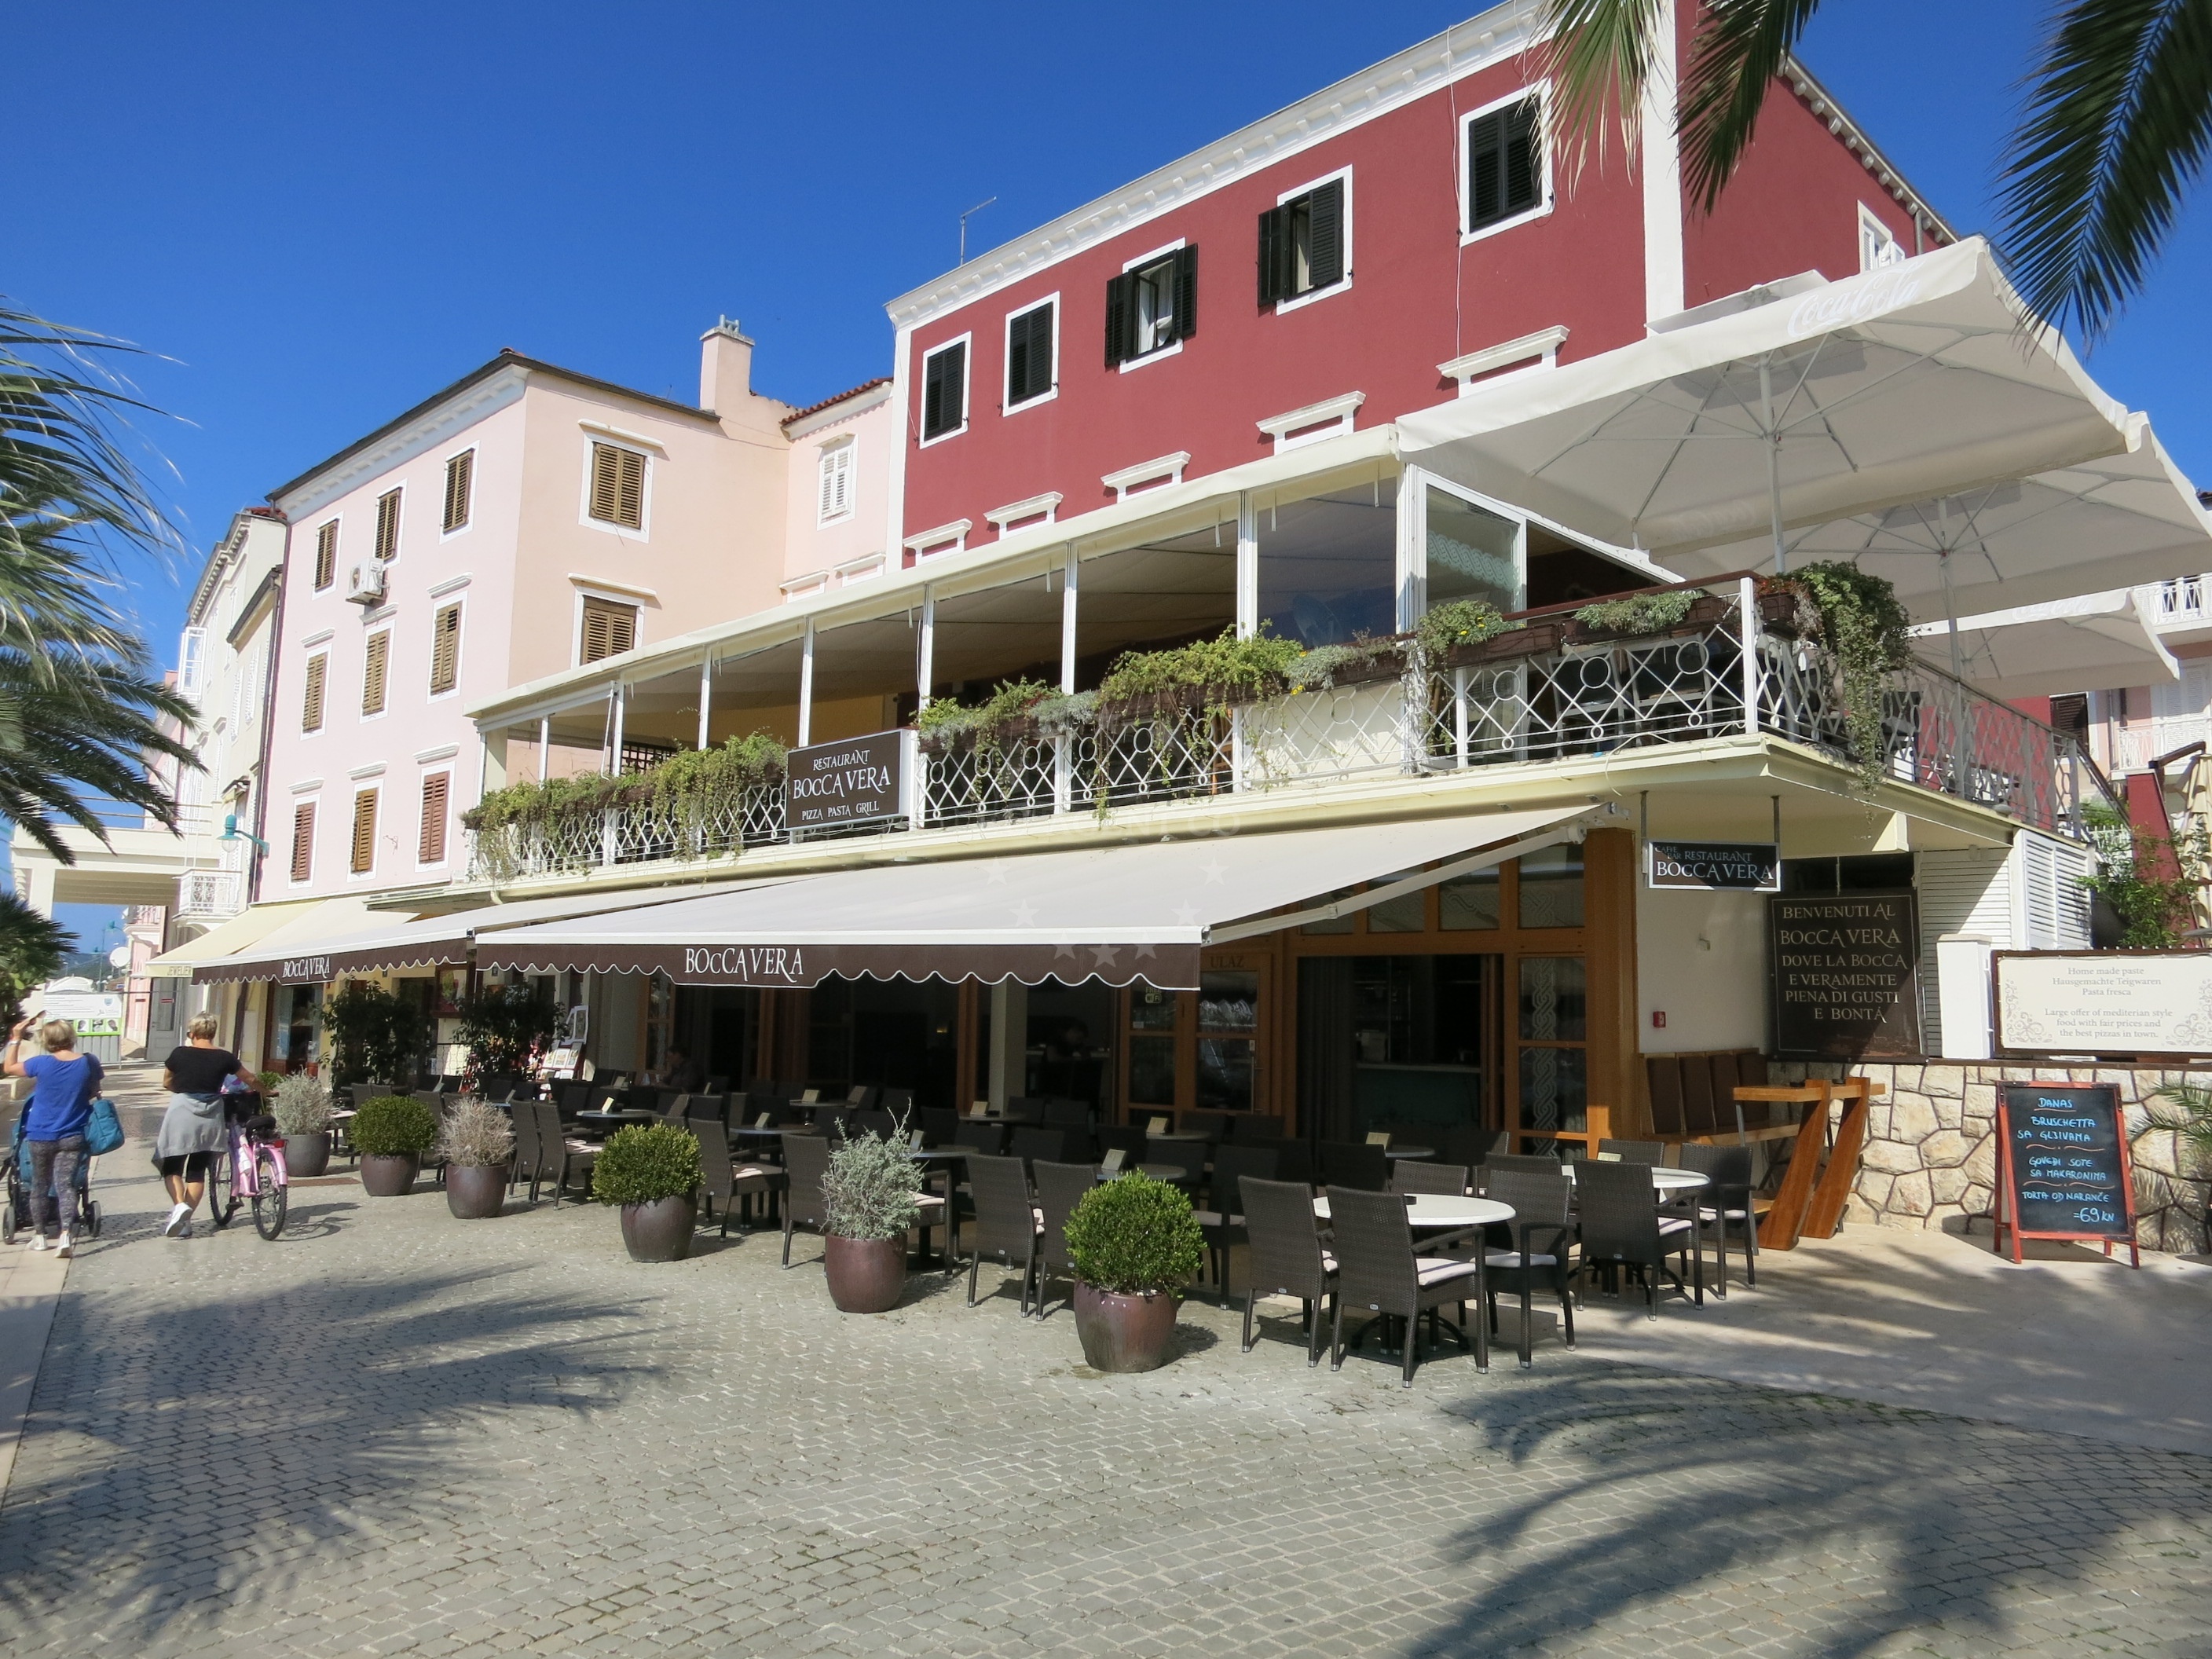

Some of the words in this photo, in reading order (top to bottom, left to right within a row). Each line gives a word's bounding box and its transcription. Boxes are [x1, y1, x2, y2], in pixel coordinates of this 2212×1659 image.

[813, 749, 870, 771] RESTAURANT
[793, 773, 845, 800] BOCCA
[845, 765, 891, 793] VERA
[801, 808, 823, 821] PIZZA
[828, 804, 851, 818] PASTA
[856, 801, 880, 816] GRILL
[1684, 851, 1752, 863] RESTAURANT
[1656, 861, 1722, 881] BOCCA
[1722, 864, 1774, 884] VERA
[1783, 905, 1870, 919] BENVENUTI
[1873, 903, 1895, 921] AL
[1780, 930, 1846, 948] BOCCA
[1846, 928, 1902, 948] VERA
[684, 947, 748, 982] BOCCA
[749, 947, 804, 983] VERA
[1210, 955, 1245, 968] ULAZ
[1782, 955, 1822, 968] DOVE
[1826, 954, 1846, 967] LA
[1851, 954, 1909, 971] BOCCA
[281, 959, 309, 980] BOCCA
[309, 957, 330, 979] VERA
[2122, 968, 2144, 977] paste
[1789, 974, 1797, 986] E
[1800, 974, 1898, 989] VERAMENTE
[2052, 977, 2115, 987] Hausgemachte
[2116, 977, 2162, 987] Teigwaren
[1785, 990, 1829, 1003] PIENA
[1832, 991, 1848, 1003] DI
[1851, 991, 1899, 1004] GUSTI
[1815, 1008, 1823, 1020] E
[2045, 1009, 2068, 1018] Large
[2104, 1009, 2151, 1017] mediterian
[2152, 1009, 2173, 1019] style
[2056, 1018, 2077, 1027] food
[2078, 1018, 2097, 1027] with
[2099, 1018, 2115, 1027] fair
[2116, 1020, 2143, 1029] prices
[2144, 1019, 2161, 1027] and
[2094, 1029, 2121, 1038] pizzas
[2038, 1097, 2073, 1108] DANAS
[2031, 1116, 2096, 1128] BRUSCHETTA
[2017, 1130, 2032, 1139] SA
[2068, 1158, 2093, 1167] SOTE
[2030, 1169, 2042, 1178] SA
[2046, 1170, 2107, 1181] MAKARONIMA
[2021, 1191, 2049, 1200] TORTA
[2052, 1192, 2064, 1203] OD
[2066, 1192, 2111, 1203] NARANČE
[2101, 1213, 2115, 1222] KN
